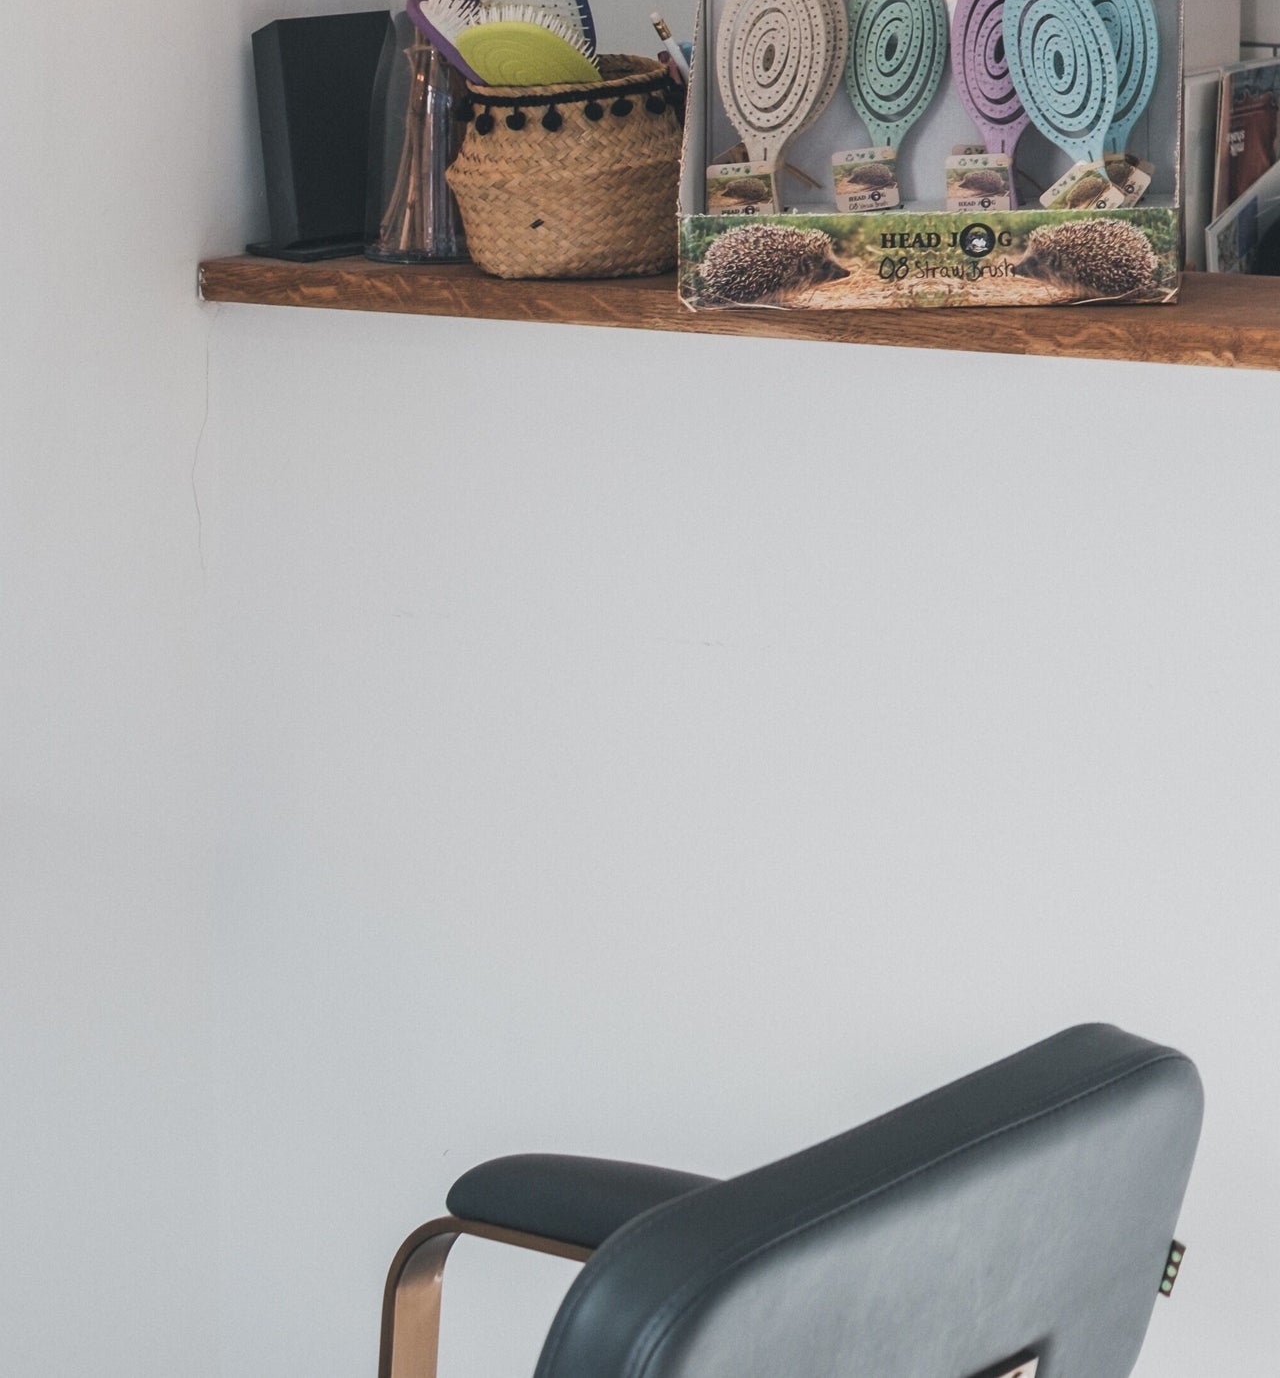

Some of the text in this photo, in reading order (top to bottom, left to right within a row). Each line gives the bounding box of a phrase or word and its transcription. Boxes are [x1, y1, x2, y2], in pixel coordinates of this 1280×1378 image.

[880, 231, 941, 249] HEAD
[915, 261, 964, 279] Straw
[966, 258, 1016, 282] Brush
